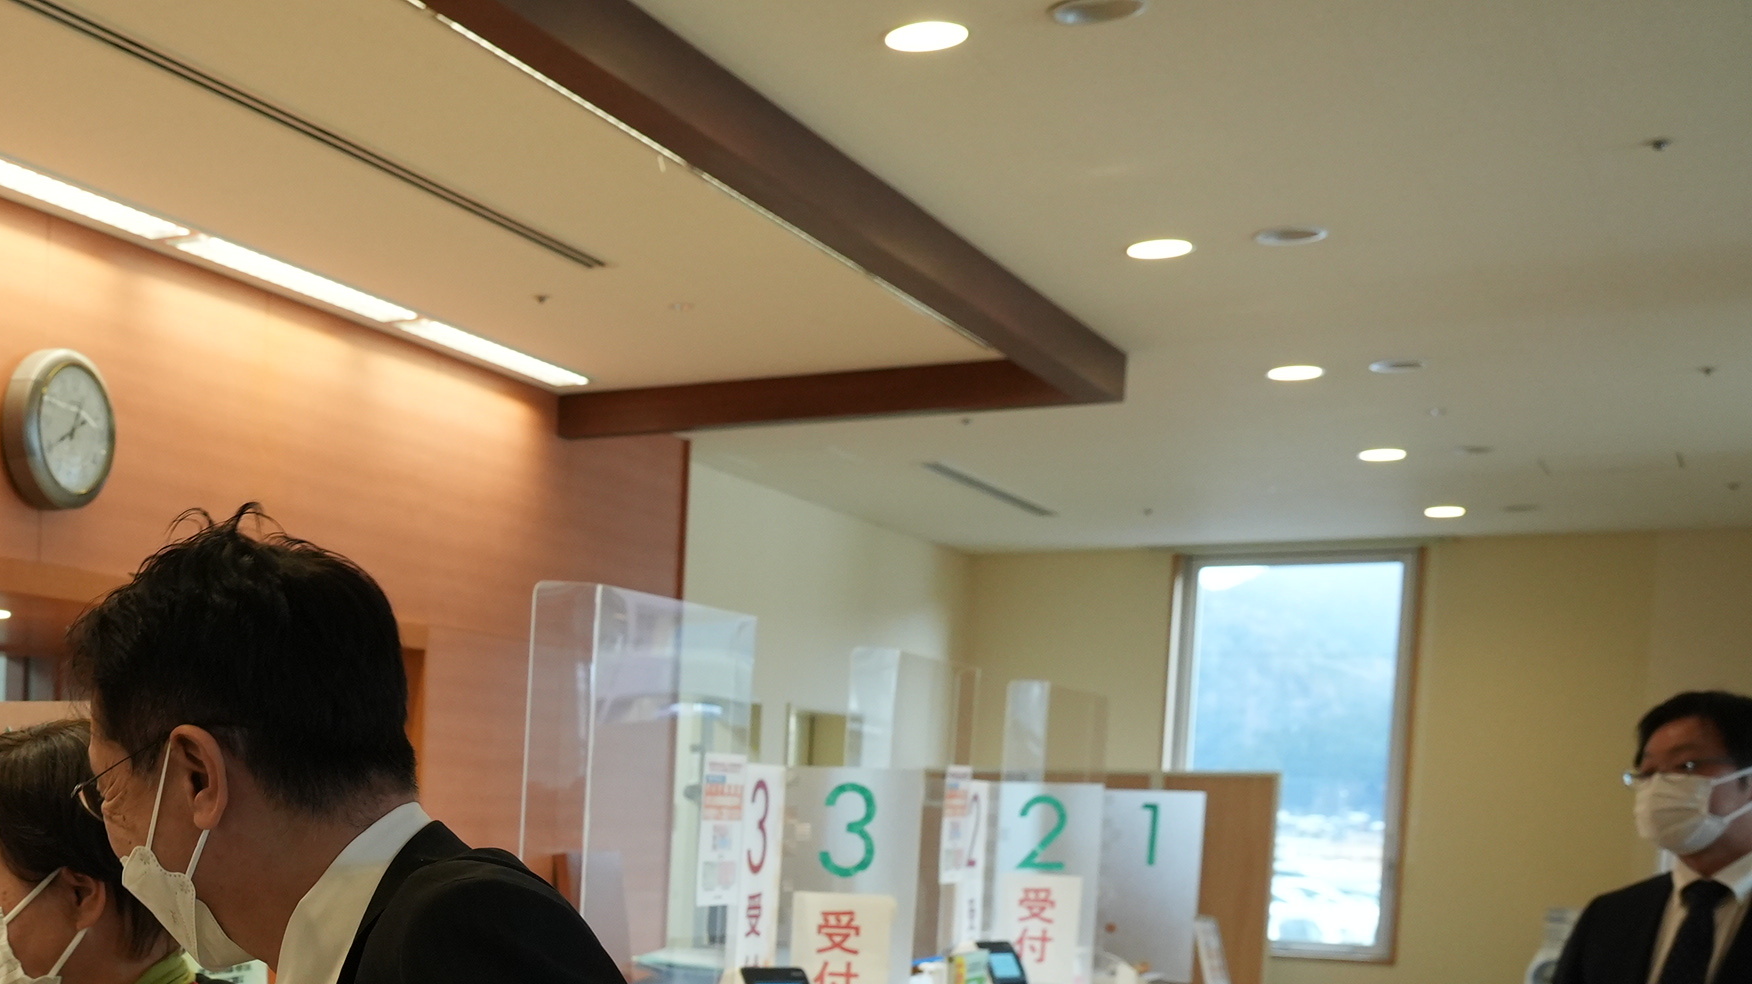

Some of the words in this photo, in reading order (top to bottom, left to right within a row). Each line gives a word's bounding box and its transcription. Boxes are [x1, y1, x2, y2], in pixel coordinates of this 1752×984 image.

[747, 778, 769, 875] 3
[818, 781, 877, 878] 3
[1016, 794, 1067, 871] 2
[1141, 803, 1159, 866] 1
[1014, 887, 1056, 964] 受付
